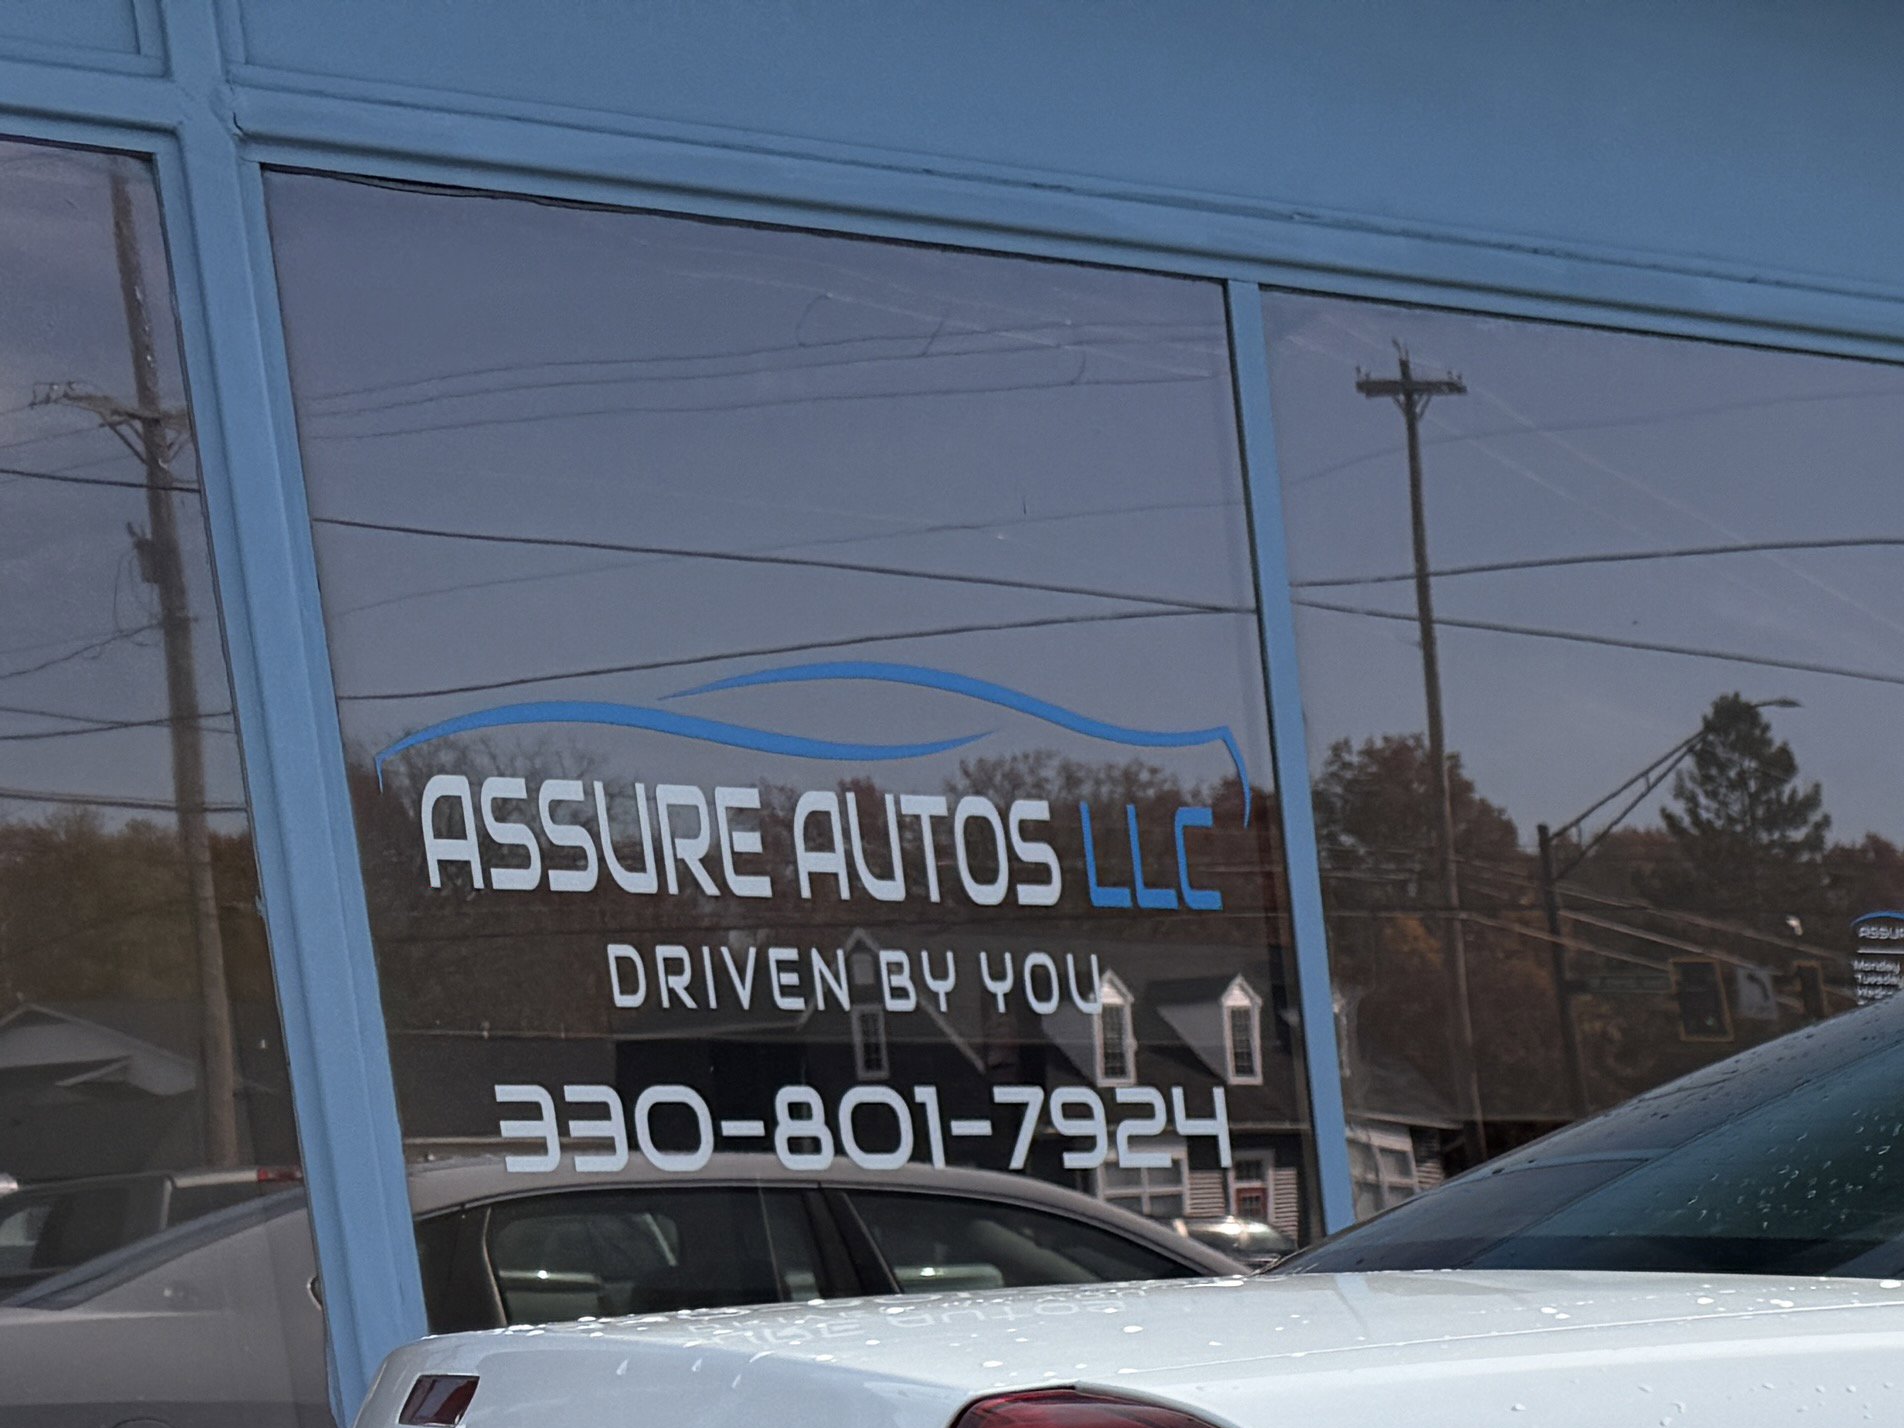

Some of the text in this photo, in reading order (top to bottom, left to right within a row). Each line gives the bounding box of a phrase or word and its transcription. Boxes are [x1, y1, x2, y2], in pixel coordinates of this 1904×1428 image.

[421, 774, 1224, 911] ASSURE AUTOS LLC
[607, 943, 1101, 1015] DRIVEN BY YOU
[1853, 960, 1900, 974] Monday
[494, 1083, 1232, 1173] 330-801-7924
